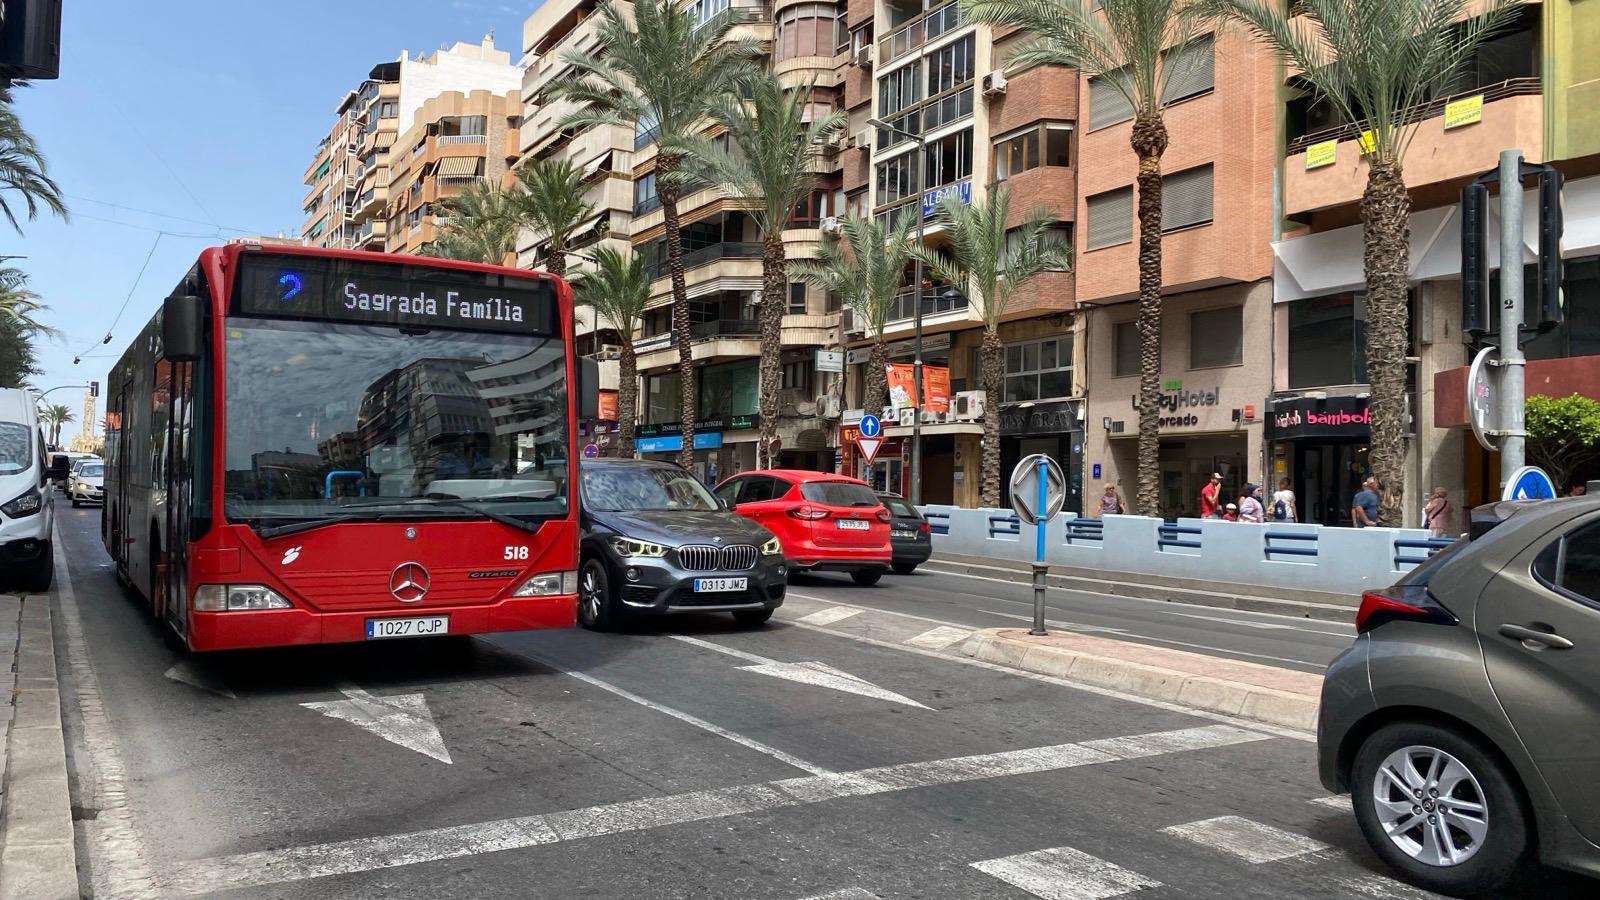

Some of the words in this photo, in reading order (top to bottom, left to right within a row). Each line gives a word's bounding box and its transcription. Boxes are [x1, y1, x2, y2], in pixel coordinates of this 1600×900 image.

[344, 283, 437, 316] Sagrada
[447, 291, 523, 322] Família
[1504, 299, 1514, 309] 2
[1157, 413, 1197, 427] ercado
[503, 546, 529, 560] 518
[702, 580, 726, 591] 0313
[729, 579, 745, 589] JMZ
[378, 621, 412, 635] 1027
[417, 619, 443, 634] CJP
